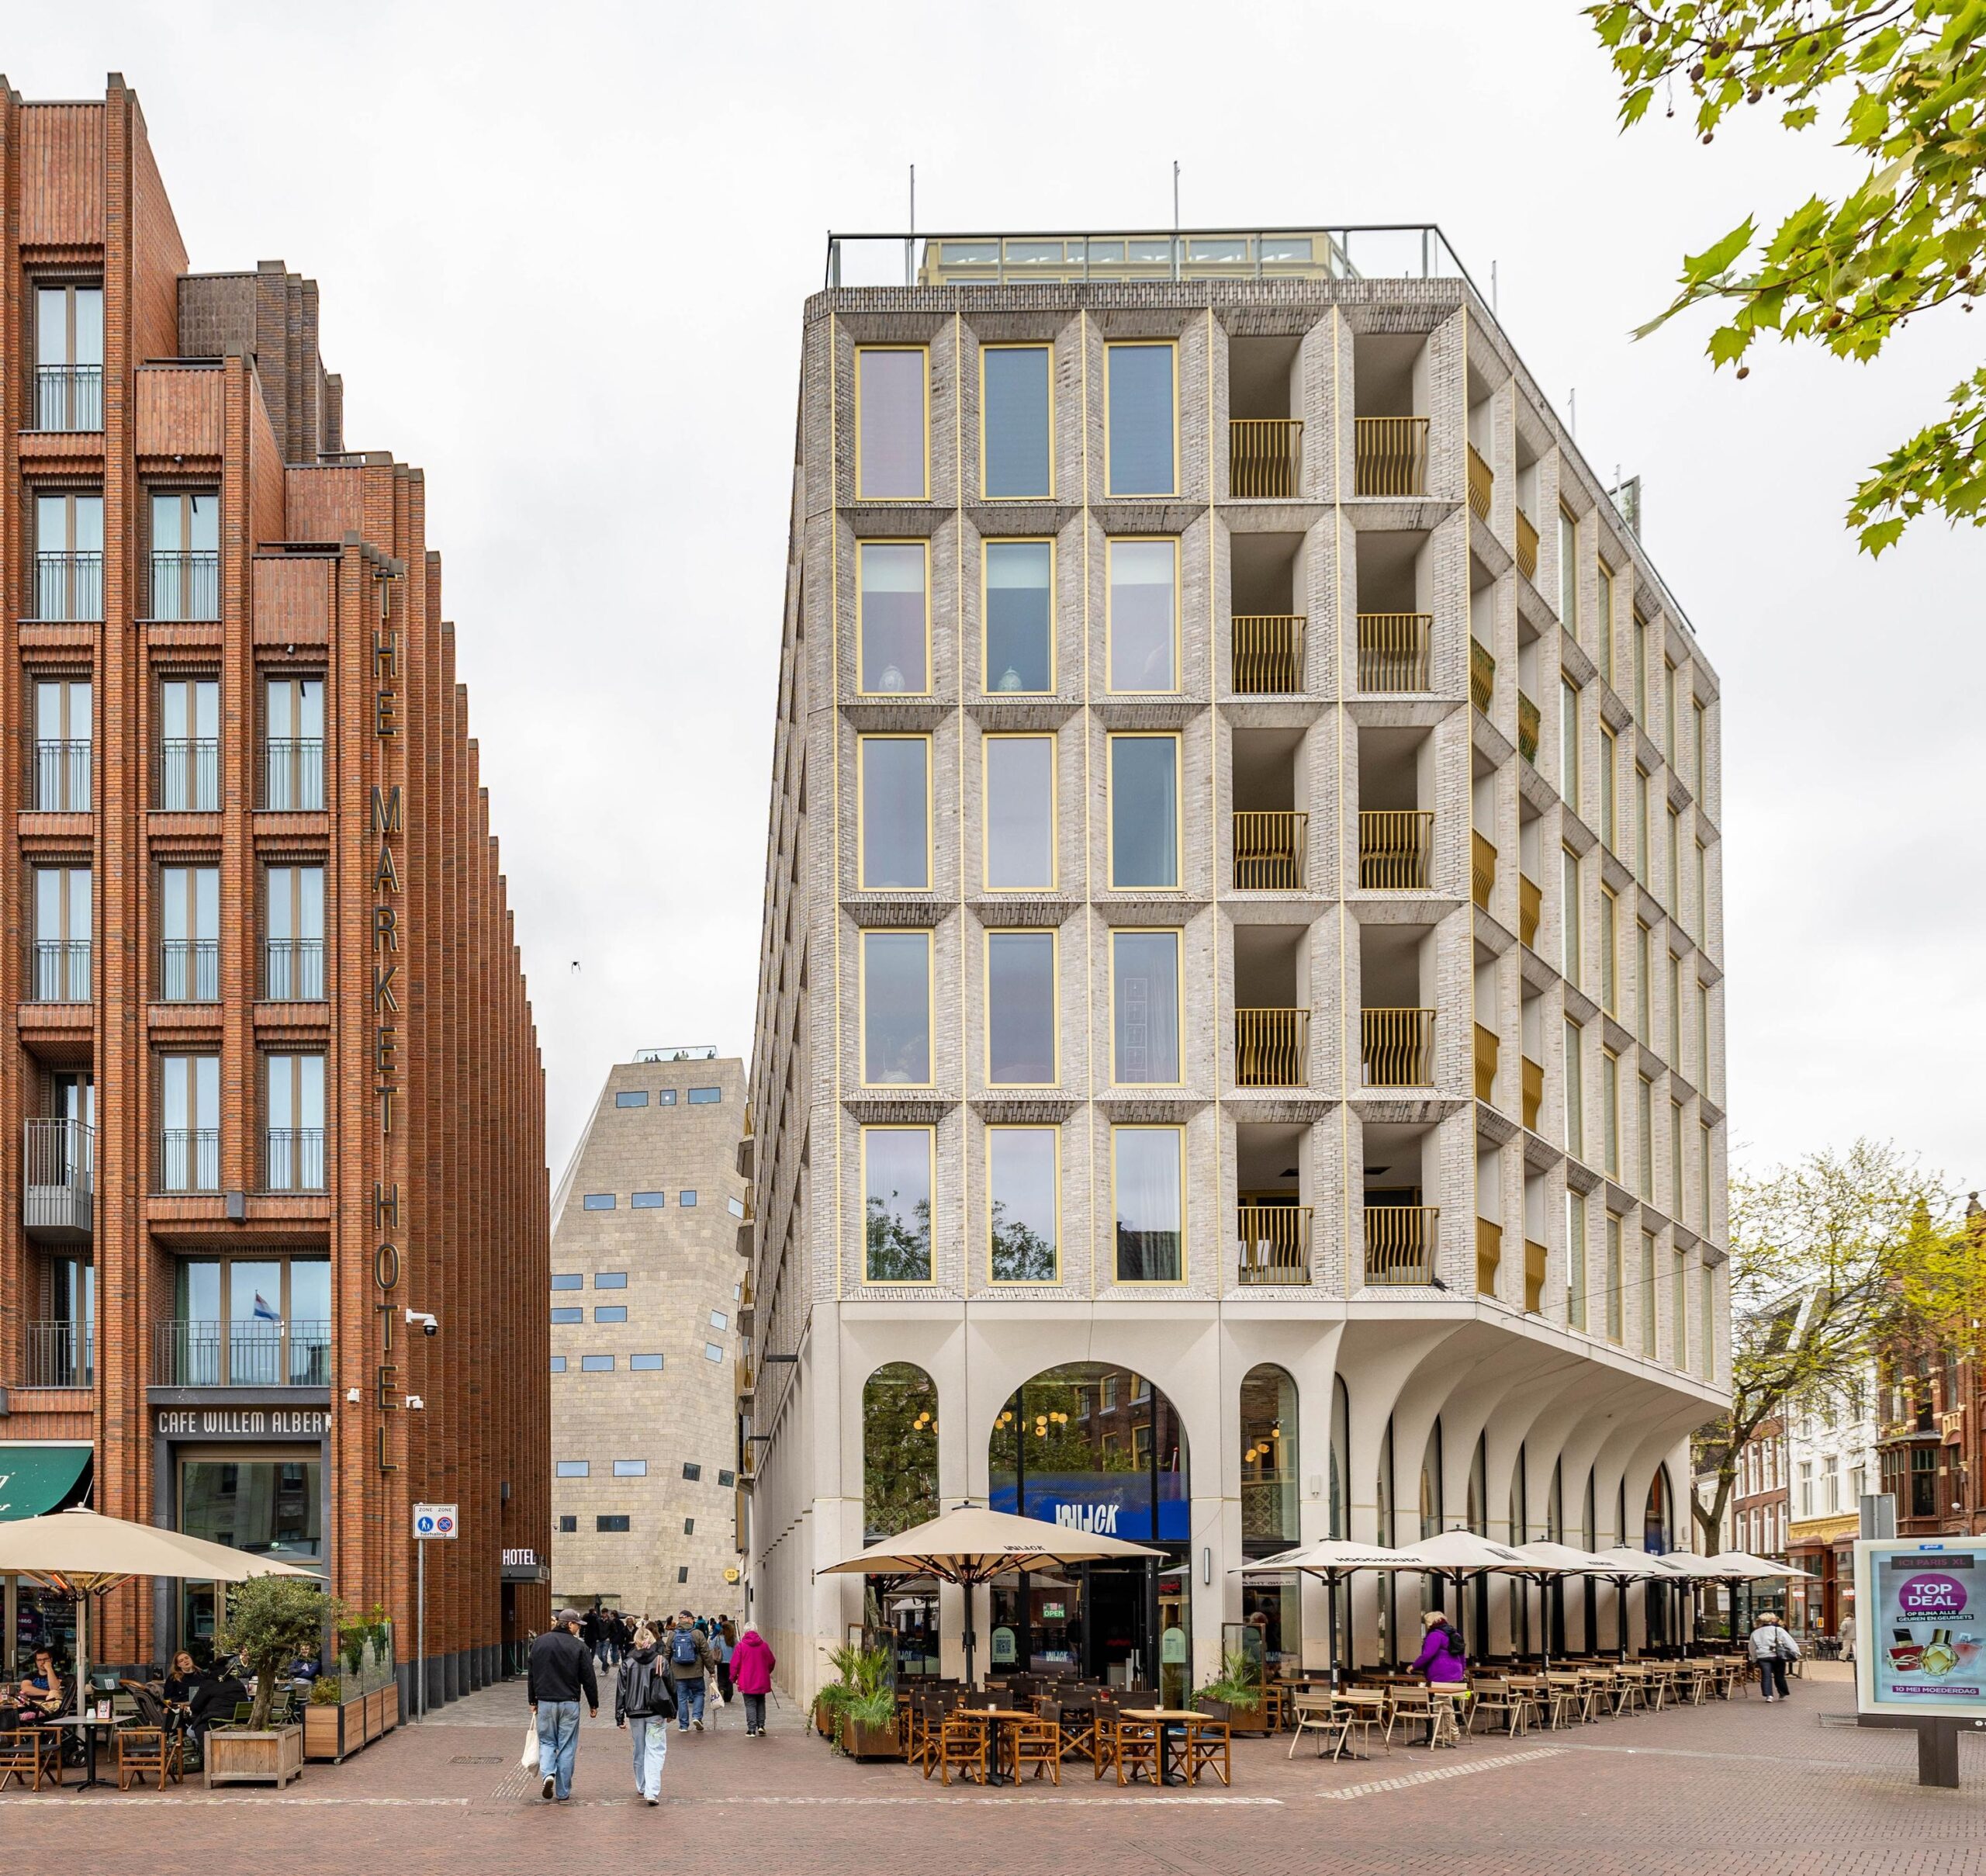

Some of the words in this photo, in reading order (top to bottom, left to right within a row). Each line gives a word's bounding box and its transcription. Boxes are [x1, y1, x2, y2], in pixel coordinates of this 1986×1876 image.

[372, 570, 399, 737] THE
[371, 785, 403, 1134] MARKET
[374, 1183, 400, 1472] HOTEL
[158, 1412, 196, 1433] CAFE
[203, 1412, 265, 1433] WILLEM
[503, 1549, 536, 1566] HOTEL
[1912, 1584, 1953, 1594] TOP
[1908, 1595, 1957, 1606] DEAL
